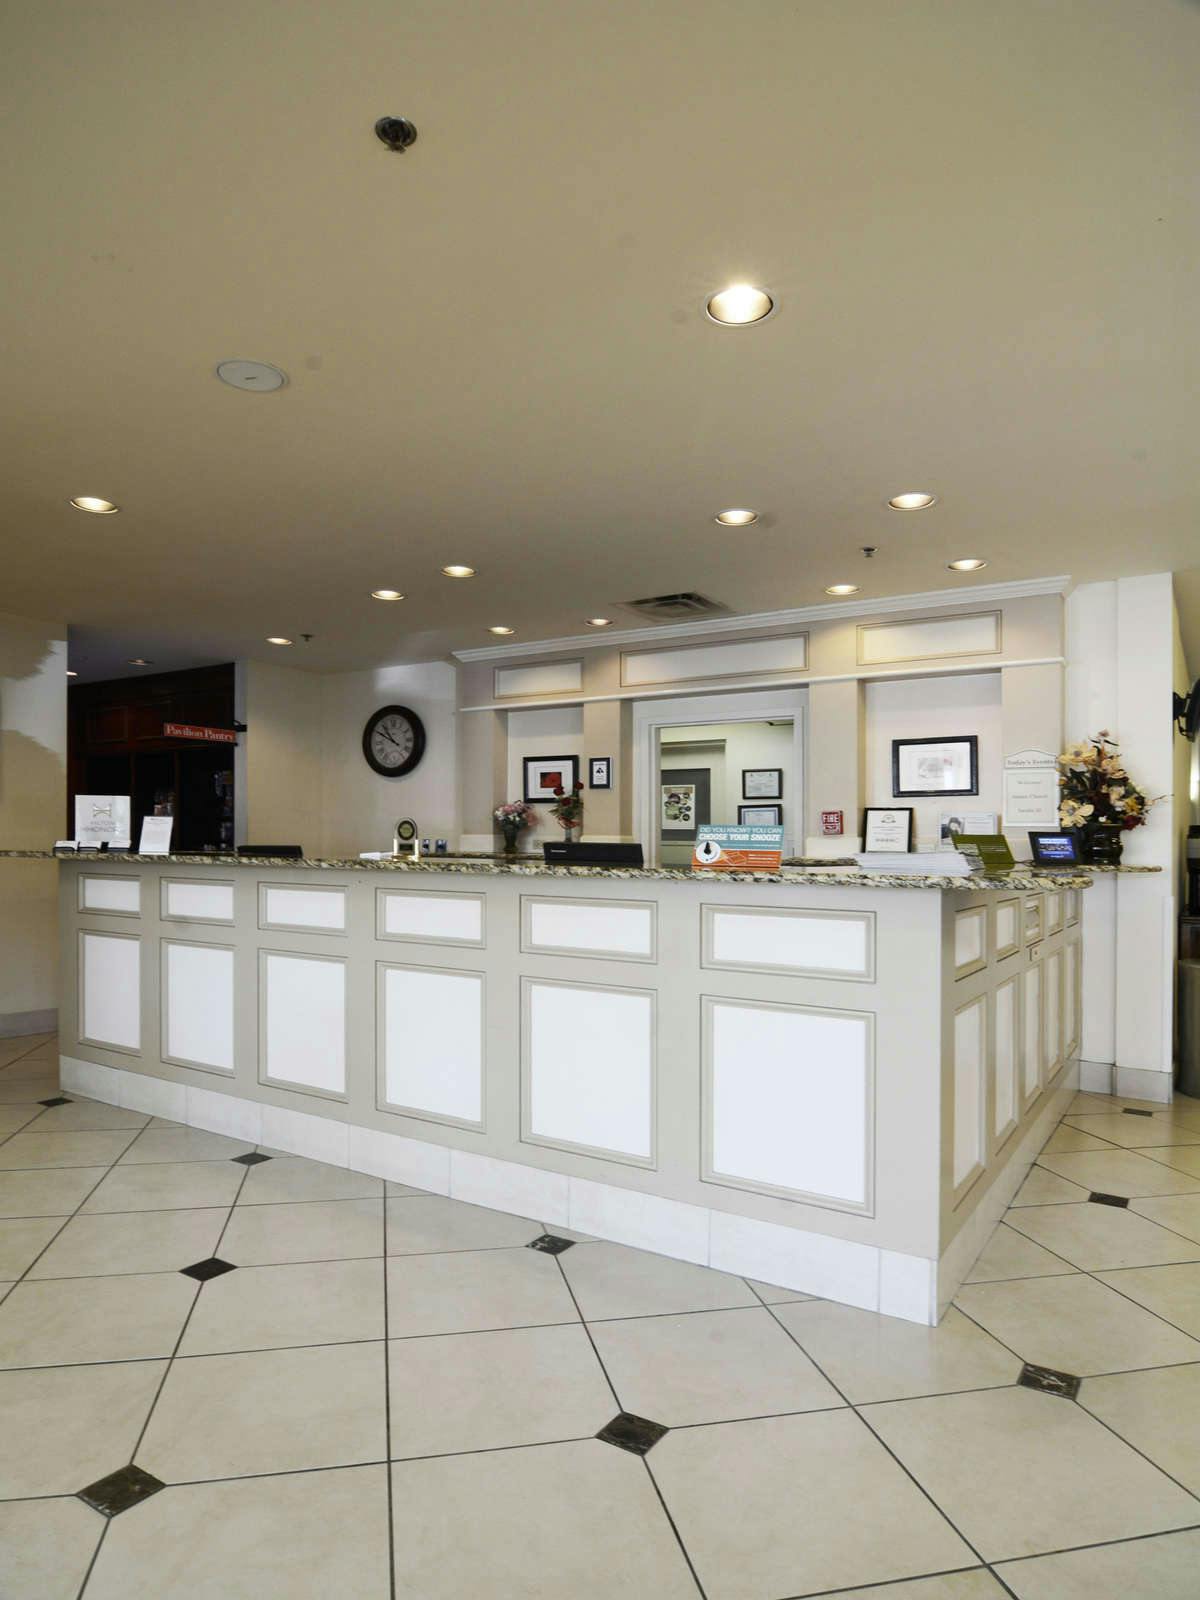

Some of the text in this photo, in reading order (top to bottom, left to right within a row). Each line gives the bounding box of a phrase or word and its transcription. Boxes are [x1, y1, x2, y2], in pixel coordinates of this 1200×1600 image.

[167, 724, 234, 741] Pavilion Pantry
[822, 813, 840, 822] FIRE
